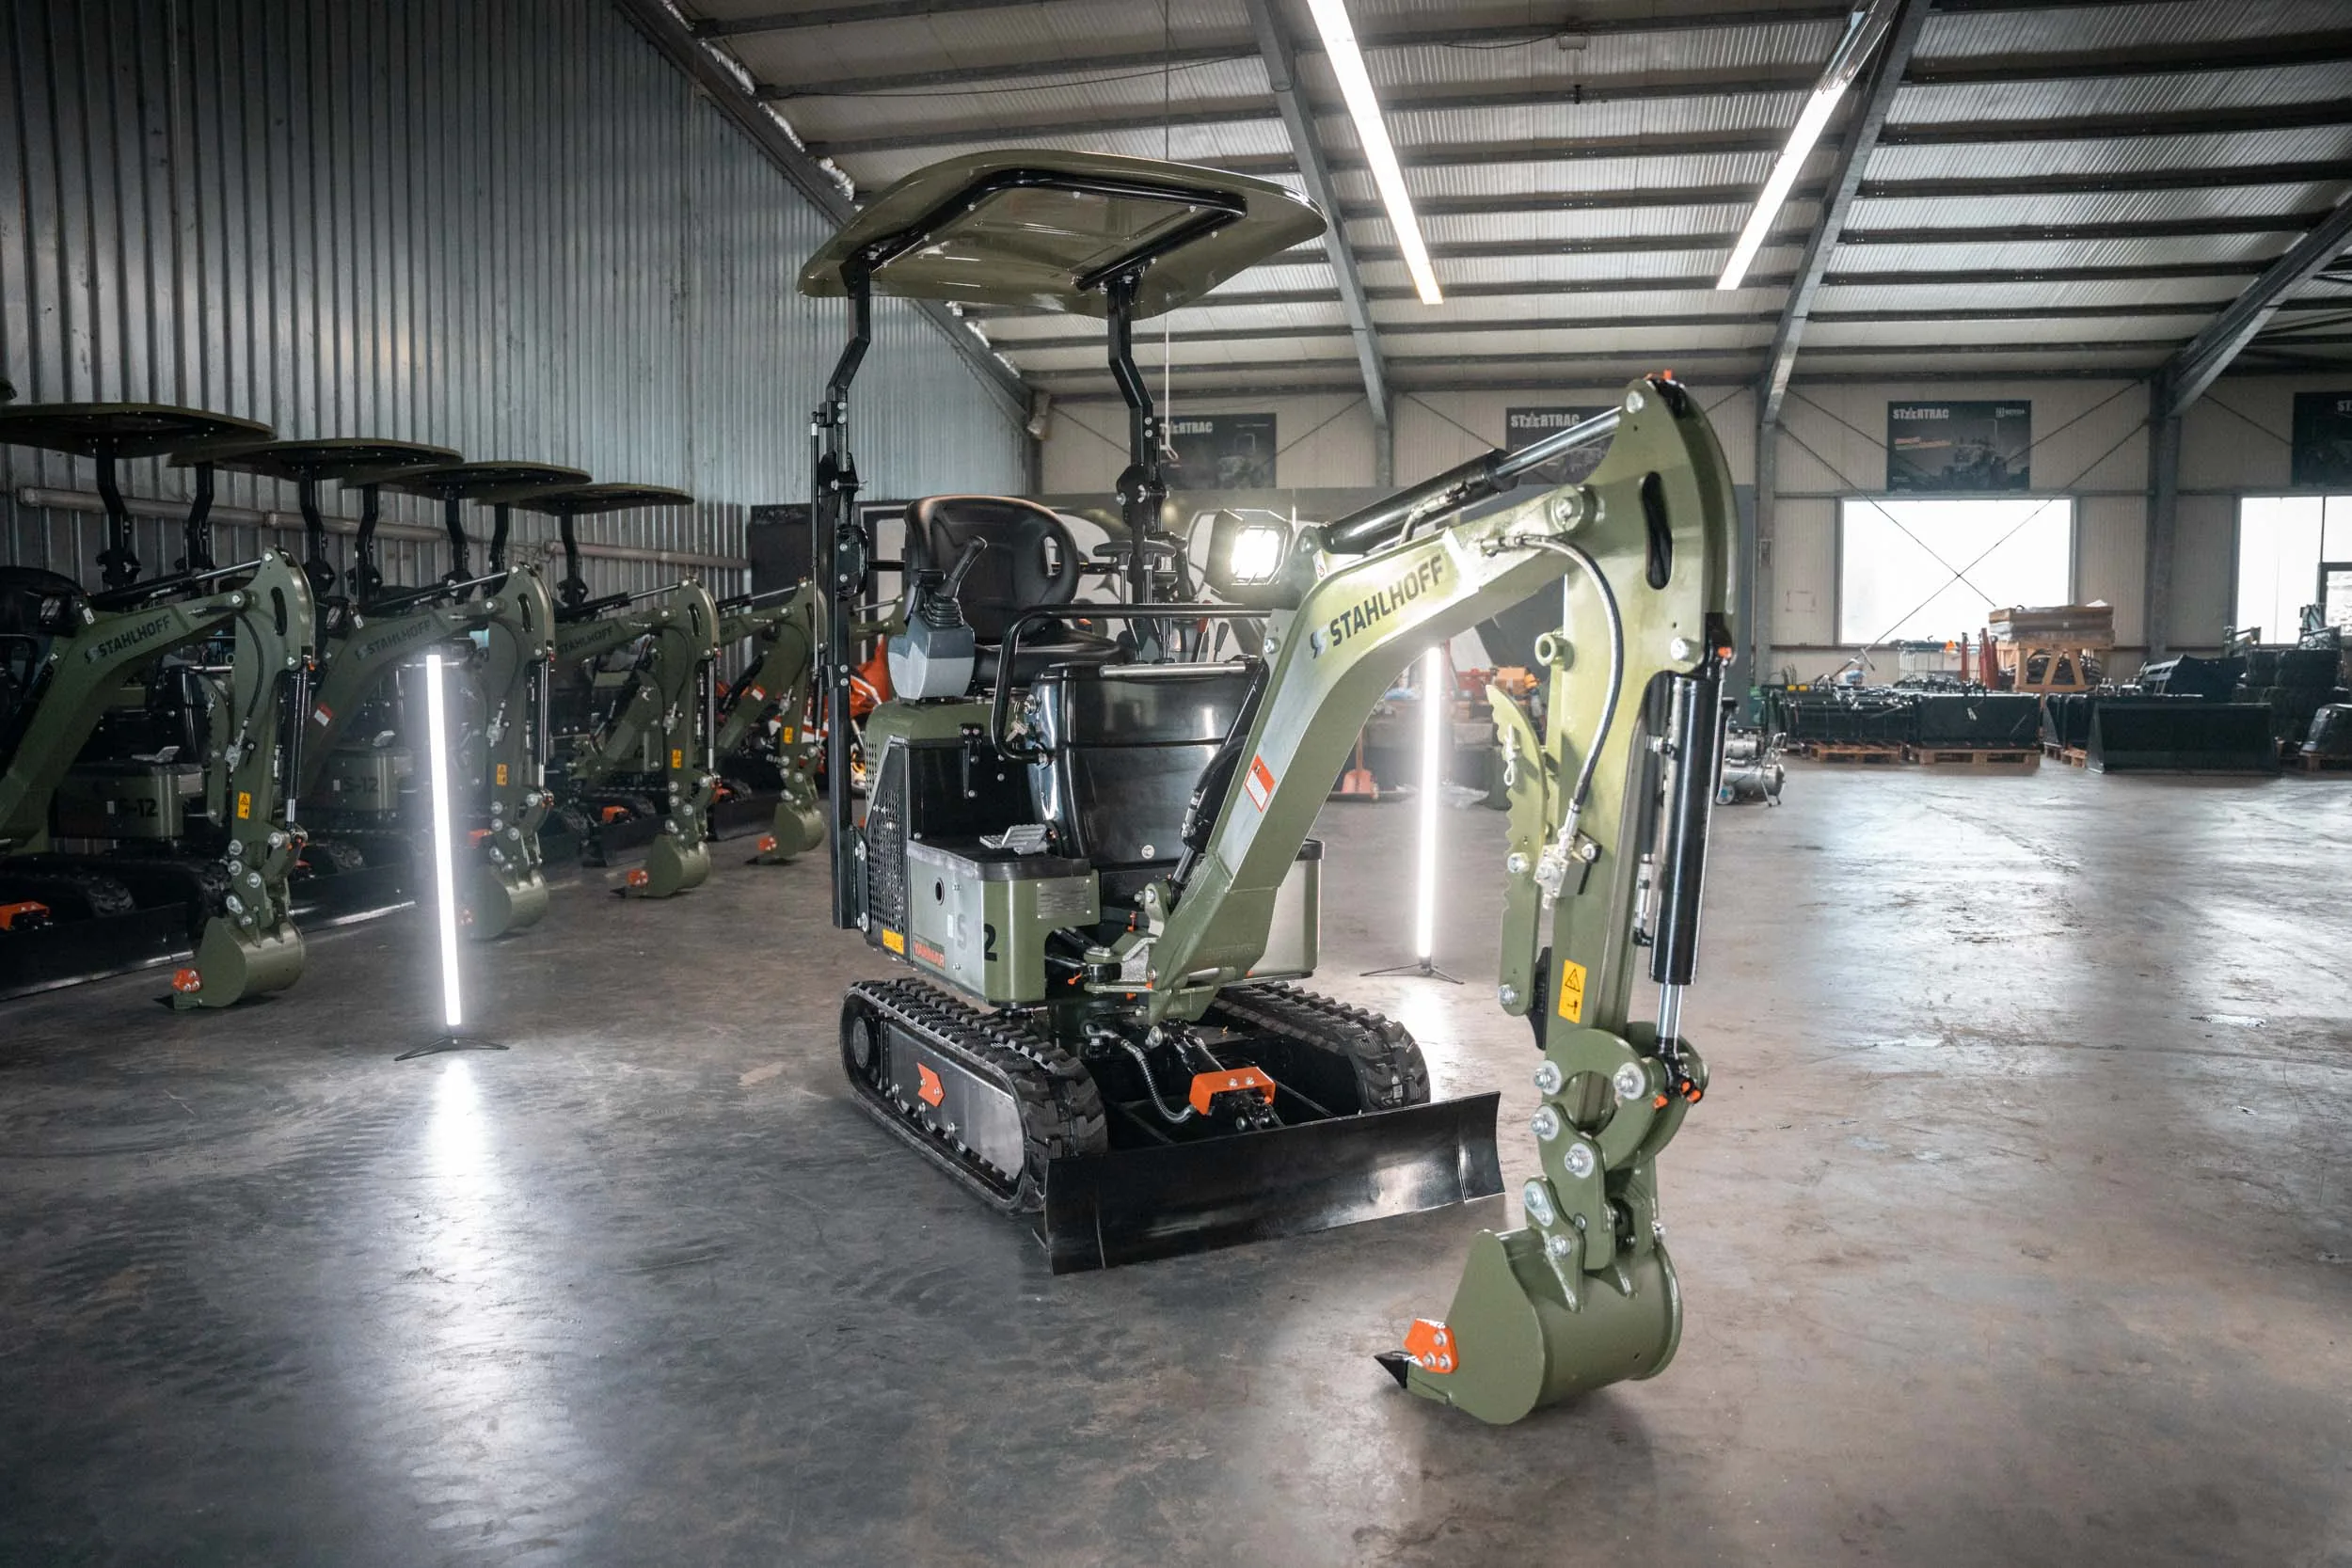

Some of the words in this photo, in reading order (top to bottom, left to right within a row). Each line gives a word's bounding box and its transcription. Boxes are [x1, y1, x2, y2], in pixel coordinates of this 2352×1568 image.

[1330, 555, 1443, 647] STAHLHOFF
[98, 614, 171, 657] STAHLHOFF
[367, 619, 431, 656] STAHLHOFF
[914, 940, 945, 969] YANMAR
